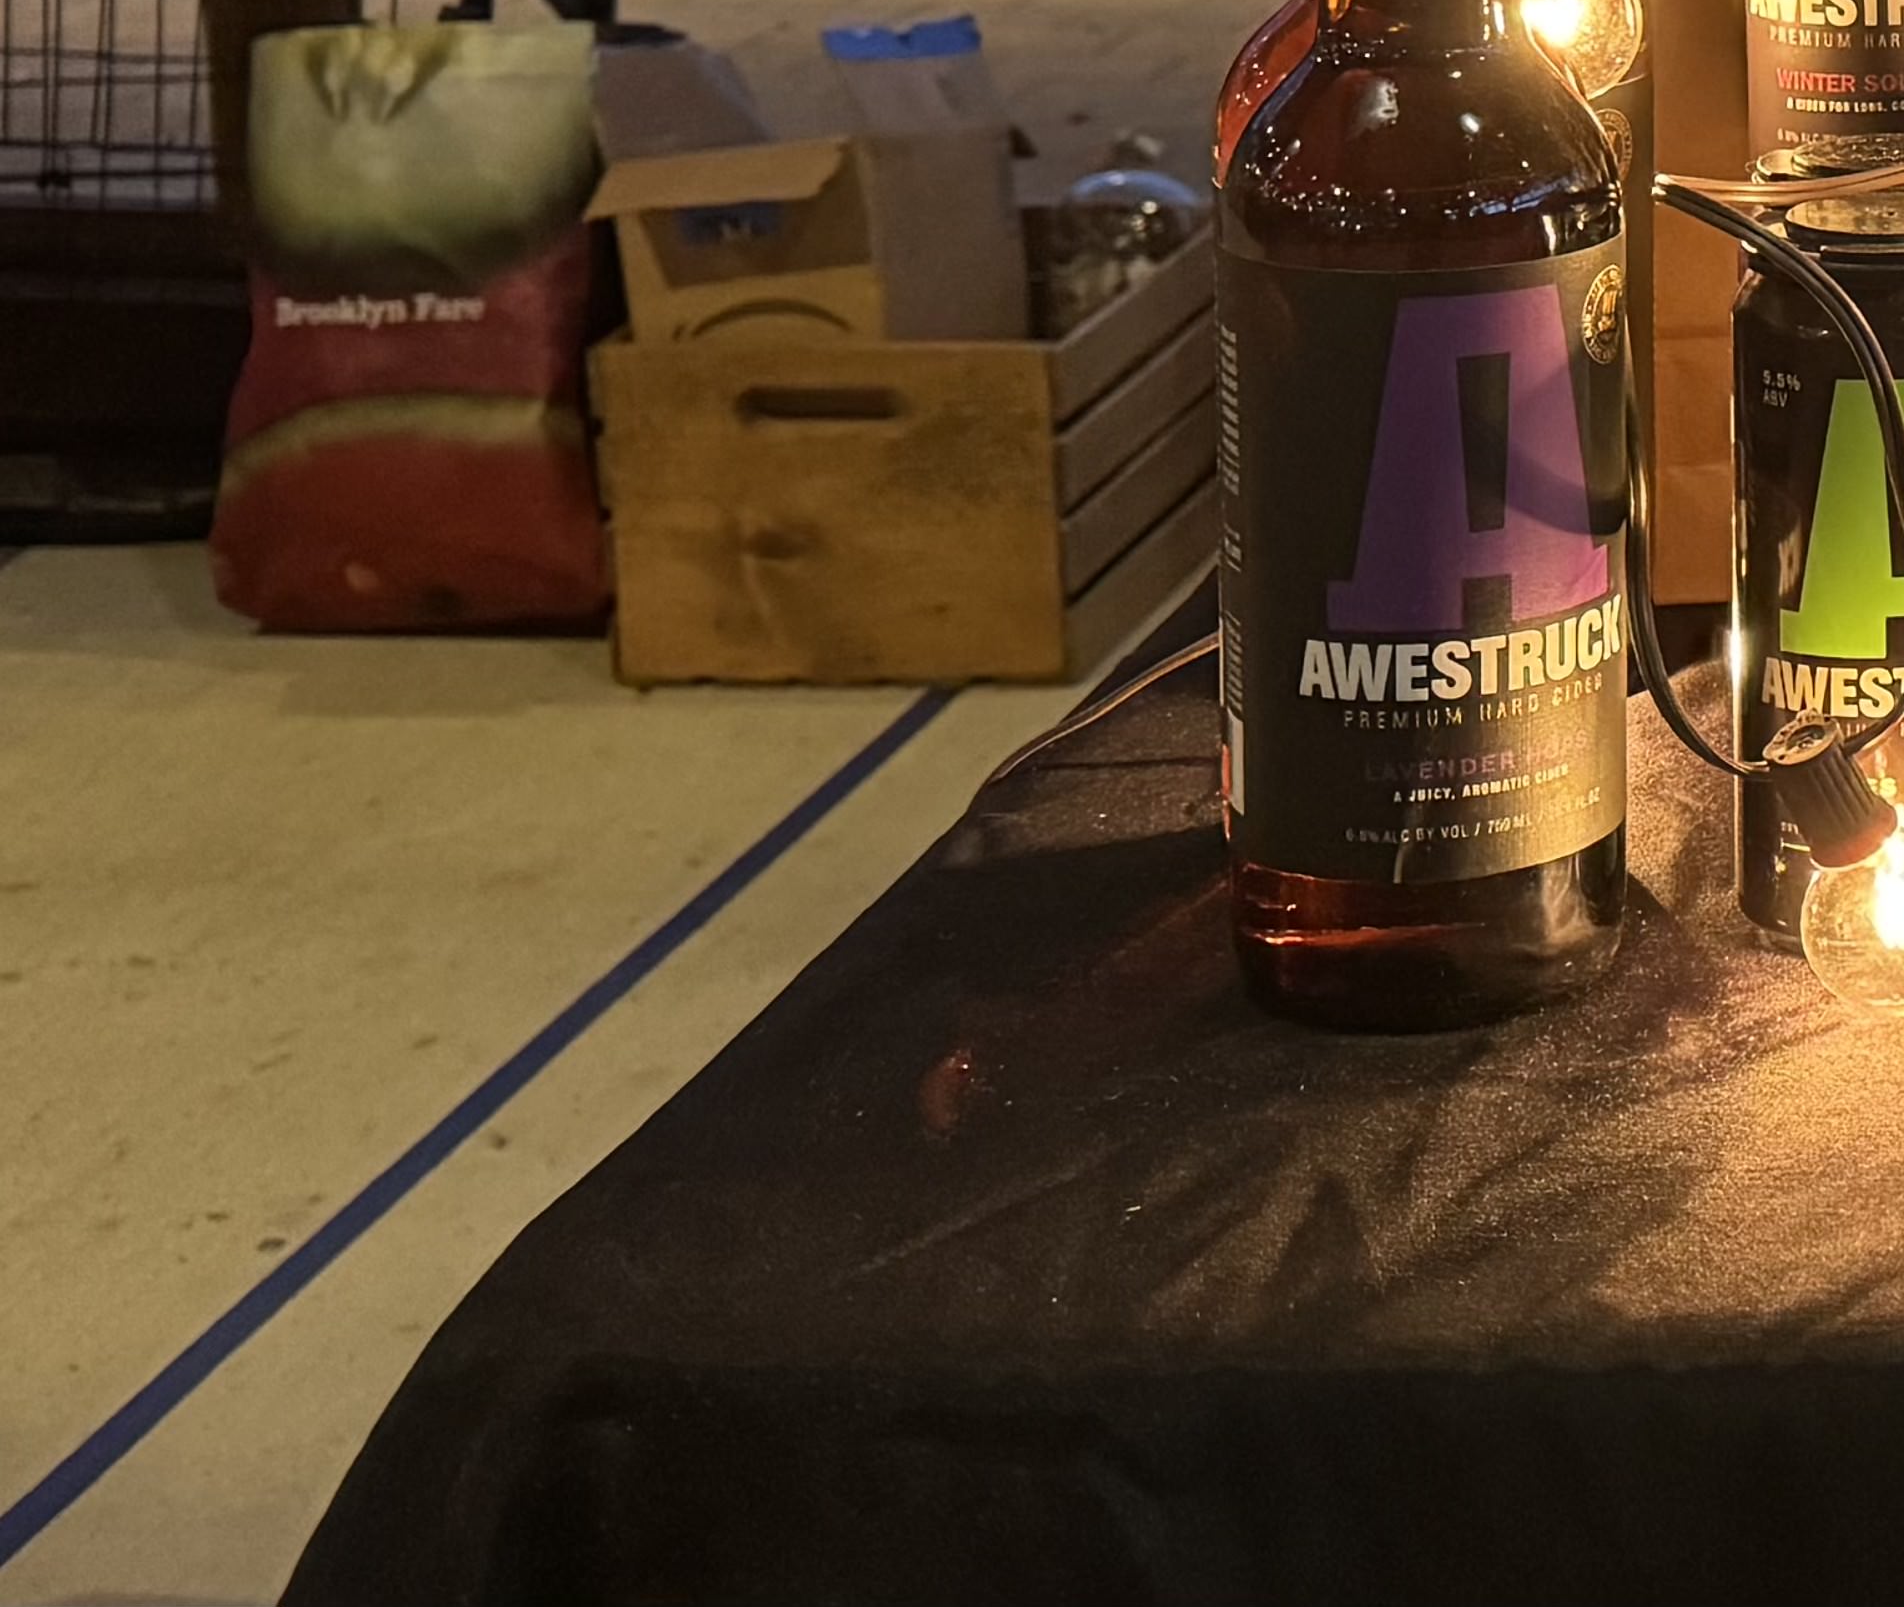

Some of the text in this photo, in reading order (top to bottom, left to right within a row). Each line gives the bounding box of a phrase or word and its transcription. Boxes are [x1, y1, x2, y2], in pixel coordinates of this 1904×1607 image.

[1776, 67, 1856, 92] WINTER
[276, 292, 484, 329] Brooklyn Fare
[1762, 369, 1800, 391] 5.5%
[1762, 389, 1788, 407] ABV
[1300, 594, 1621, 702] AWESTRUCK
[1344, 672, 1603, 729] PREMIUM HARD CIDER
[1365, 729, 1589, 781] LAVENDER HOPS
[1394, 764, 1568, 803] A JUICY, AROMATIC CIDER
